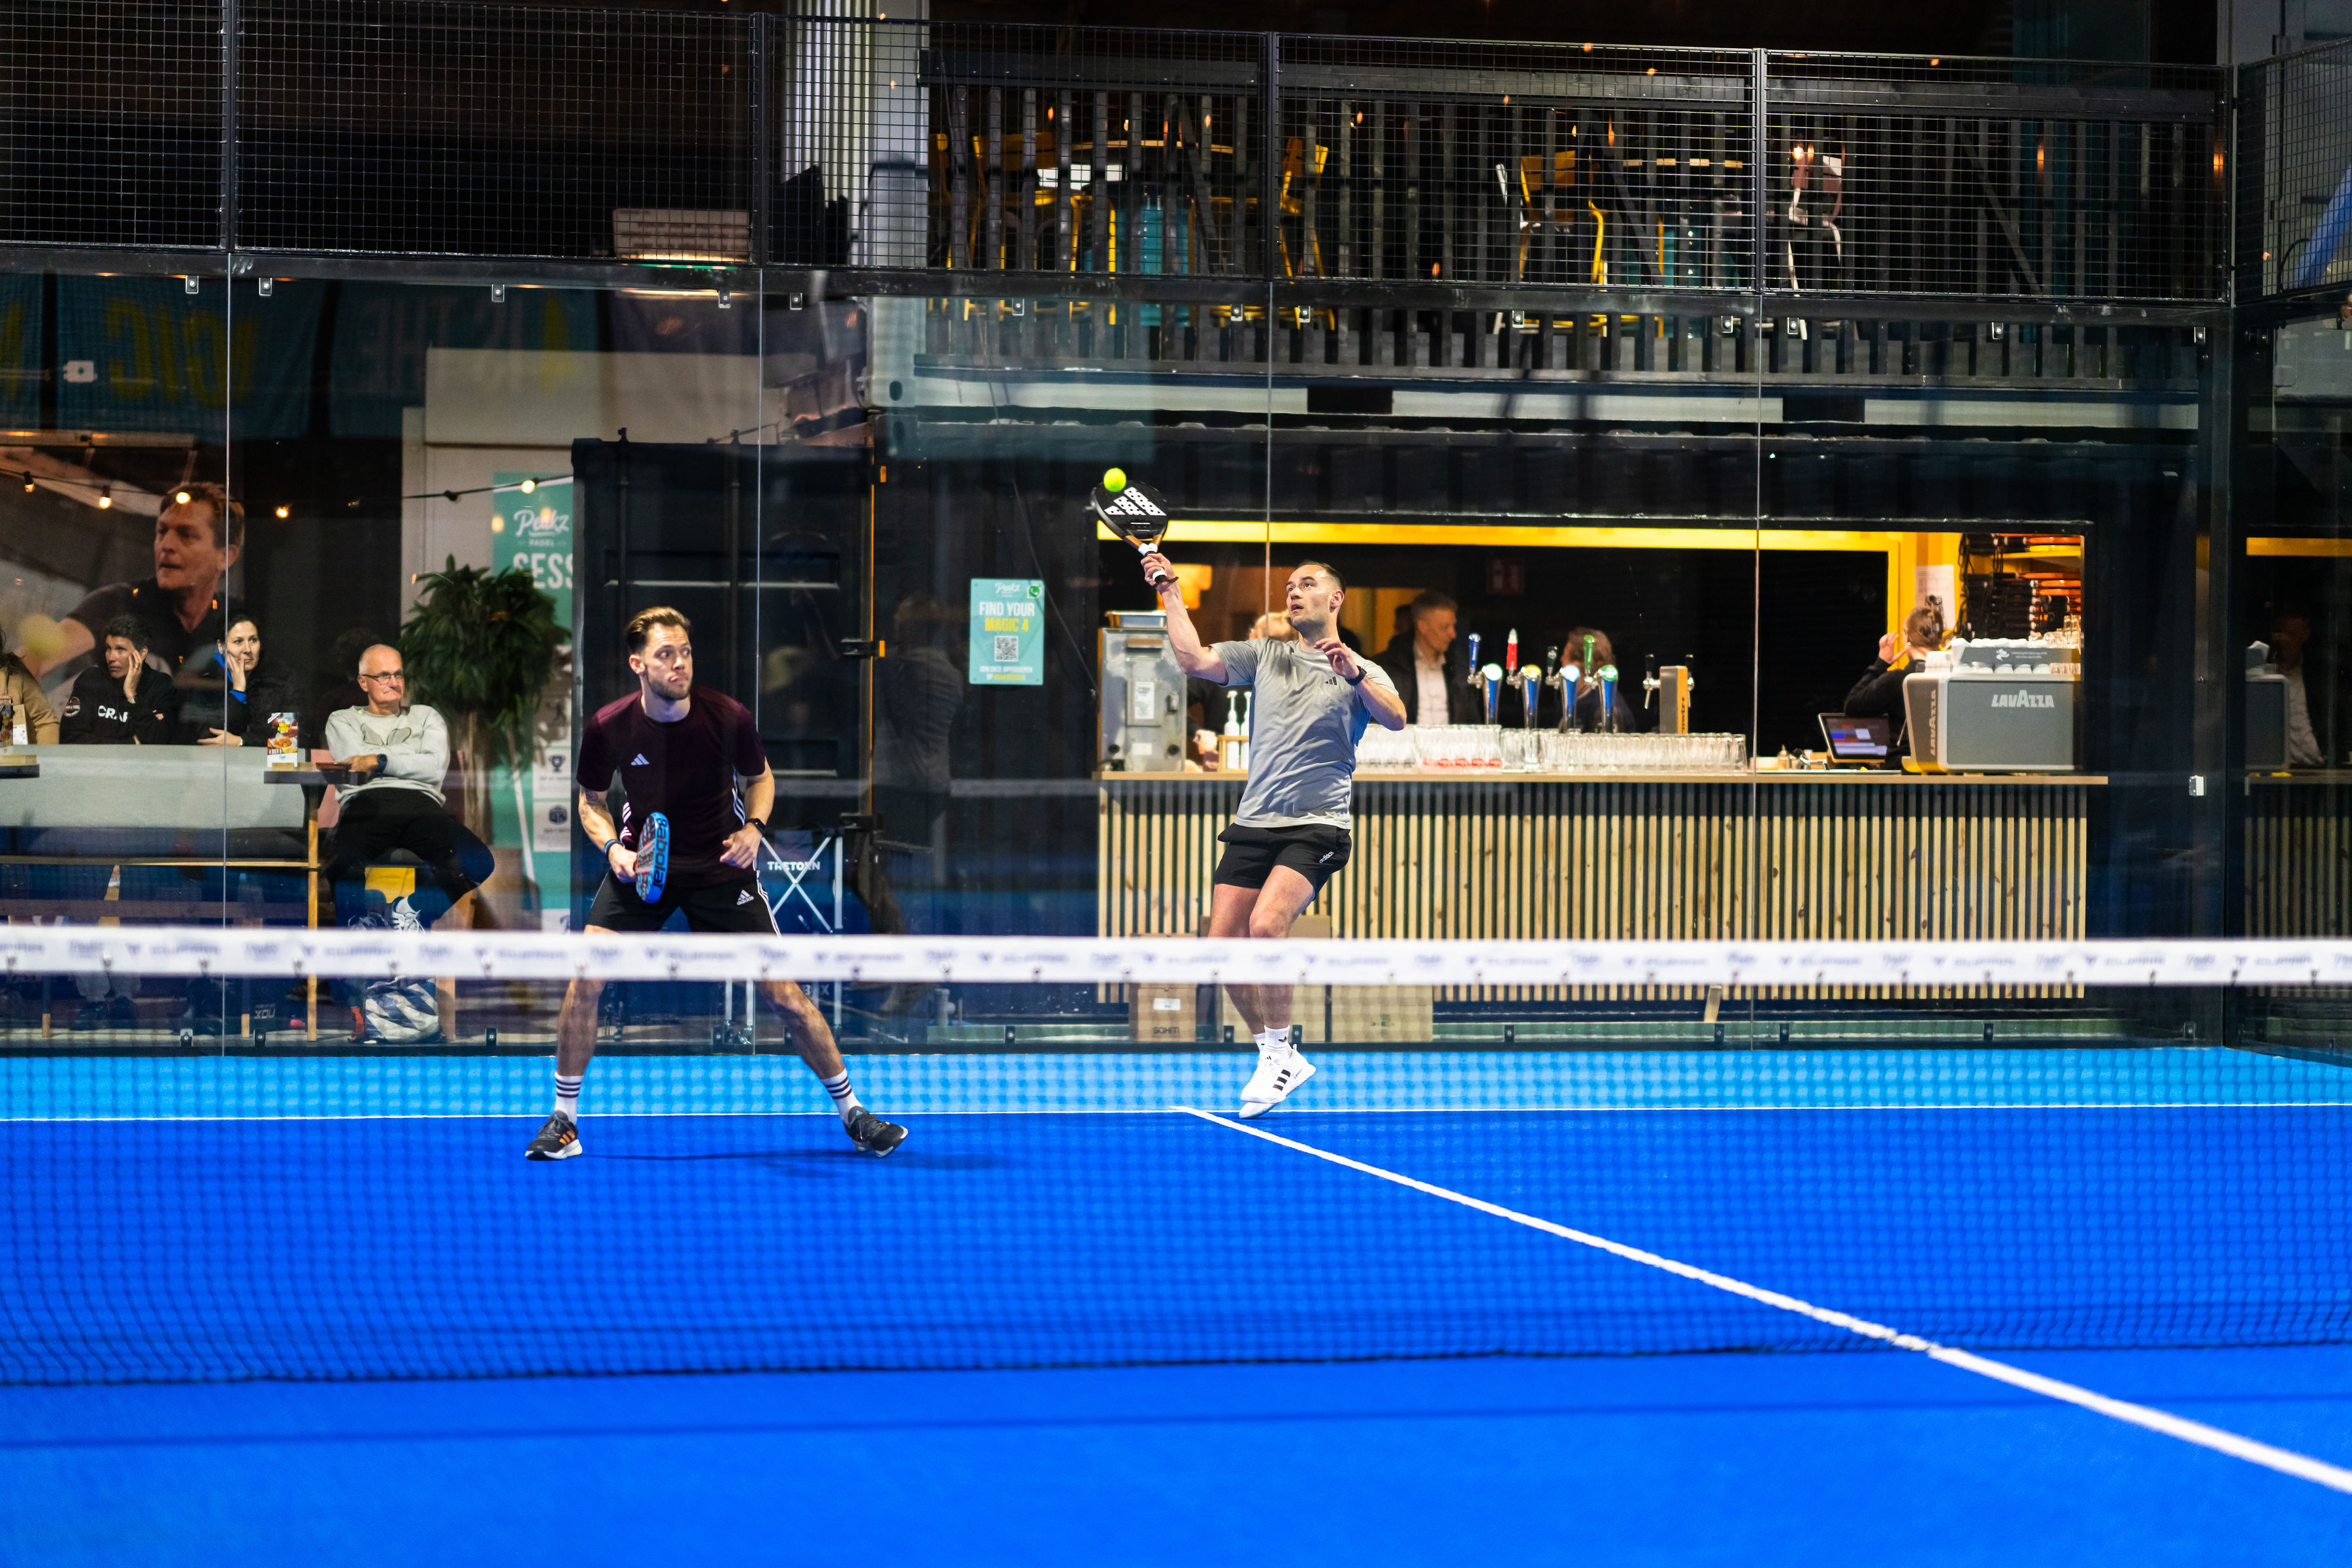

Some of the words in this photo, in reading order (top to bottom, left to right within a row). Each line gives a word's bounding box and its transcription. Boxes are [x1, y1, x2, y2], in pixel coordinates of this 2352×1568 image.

[979, 602, 1004, 616] FIND
[1007, 602, 1035, 617] YOUR
[985, 617, 1019, 632] MAGIC
[1021, 618, 1029, 632] 4
[1991, 689, 2055, 708] LAVAZZA
